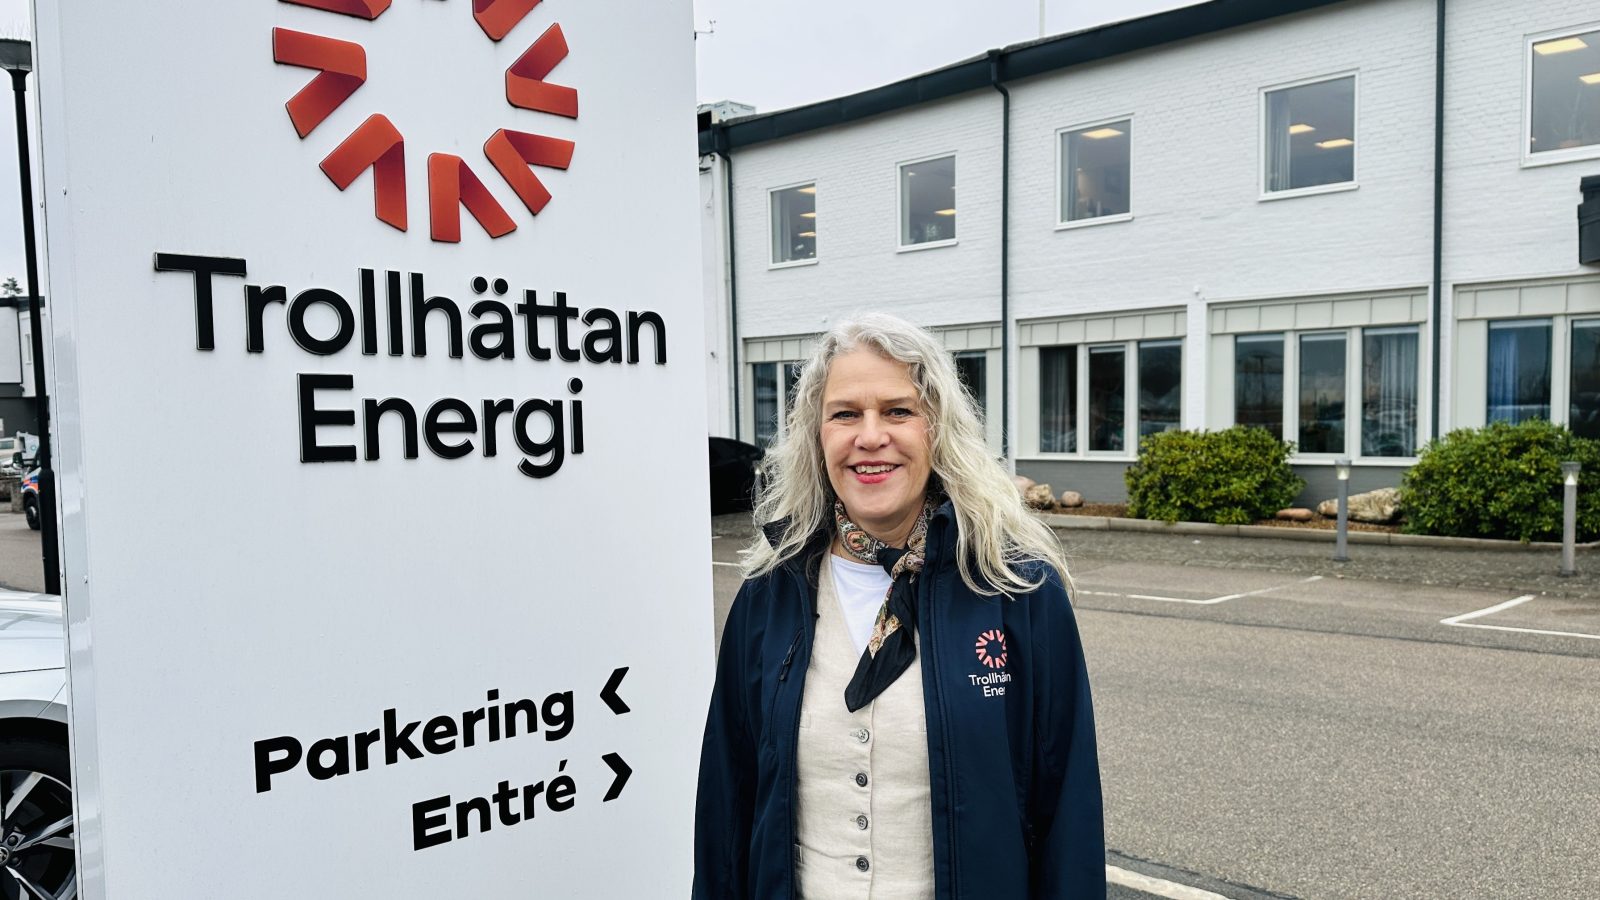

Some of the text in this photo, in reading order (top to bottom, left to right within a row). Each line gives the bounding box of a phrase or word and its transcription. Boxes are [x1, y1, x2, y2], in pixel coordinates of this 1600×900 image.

[153, 252, 668, 366] Trollhättan
[297, 373, 585, 479] Energi
[253, 688, 576, 793] Parkering
[412, 759, 578, 852] Entré
